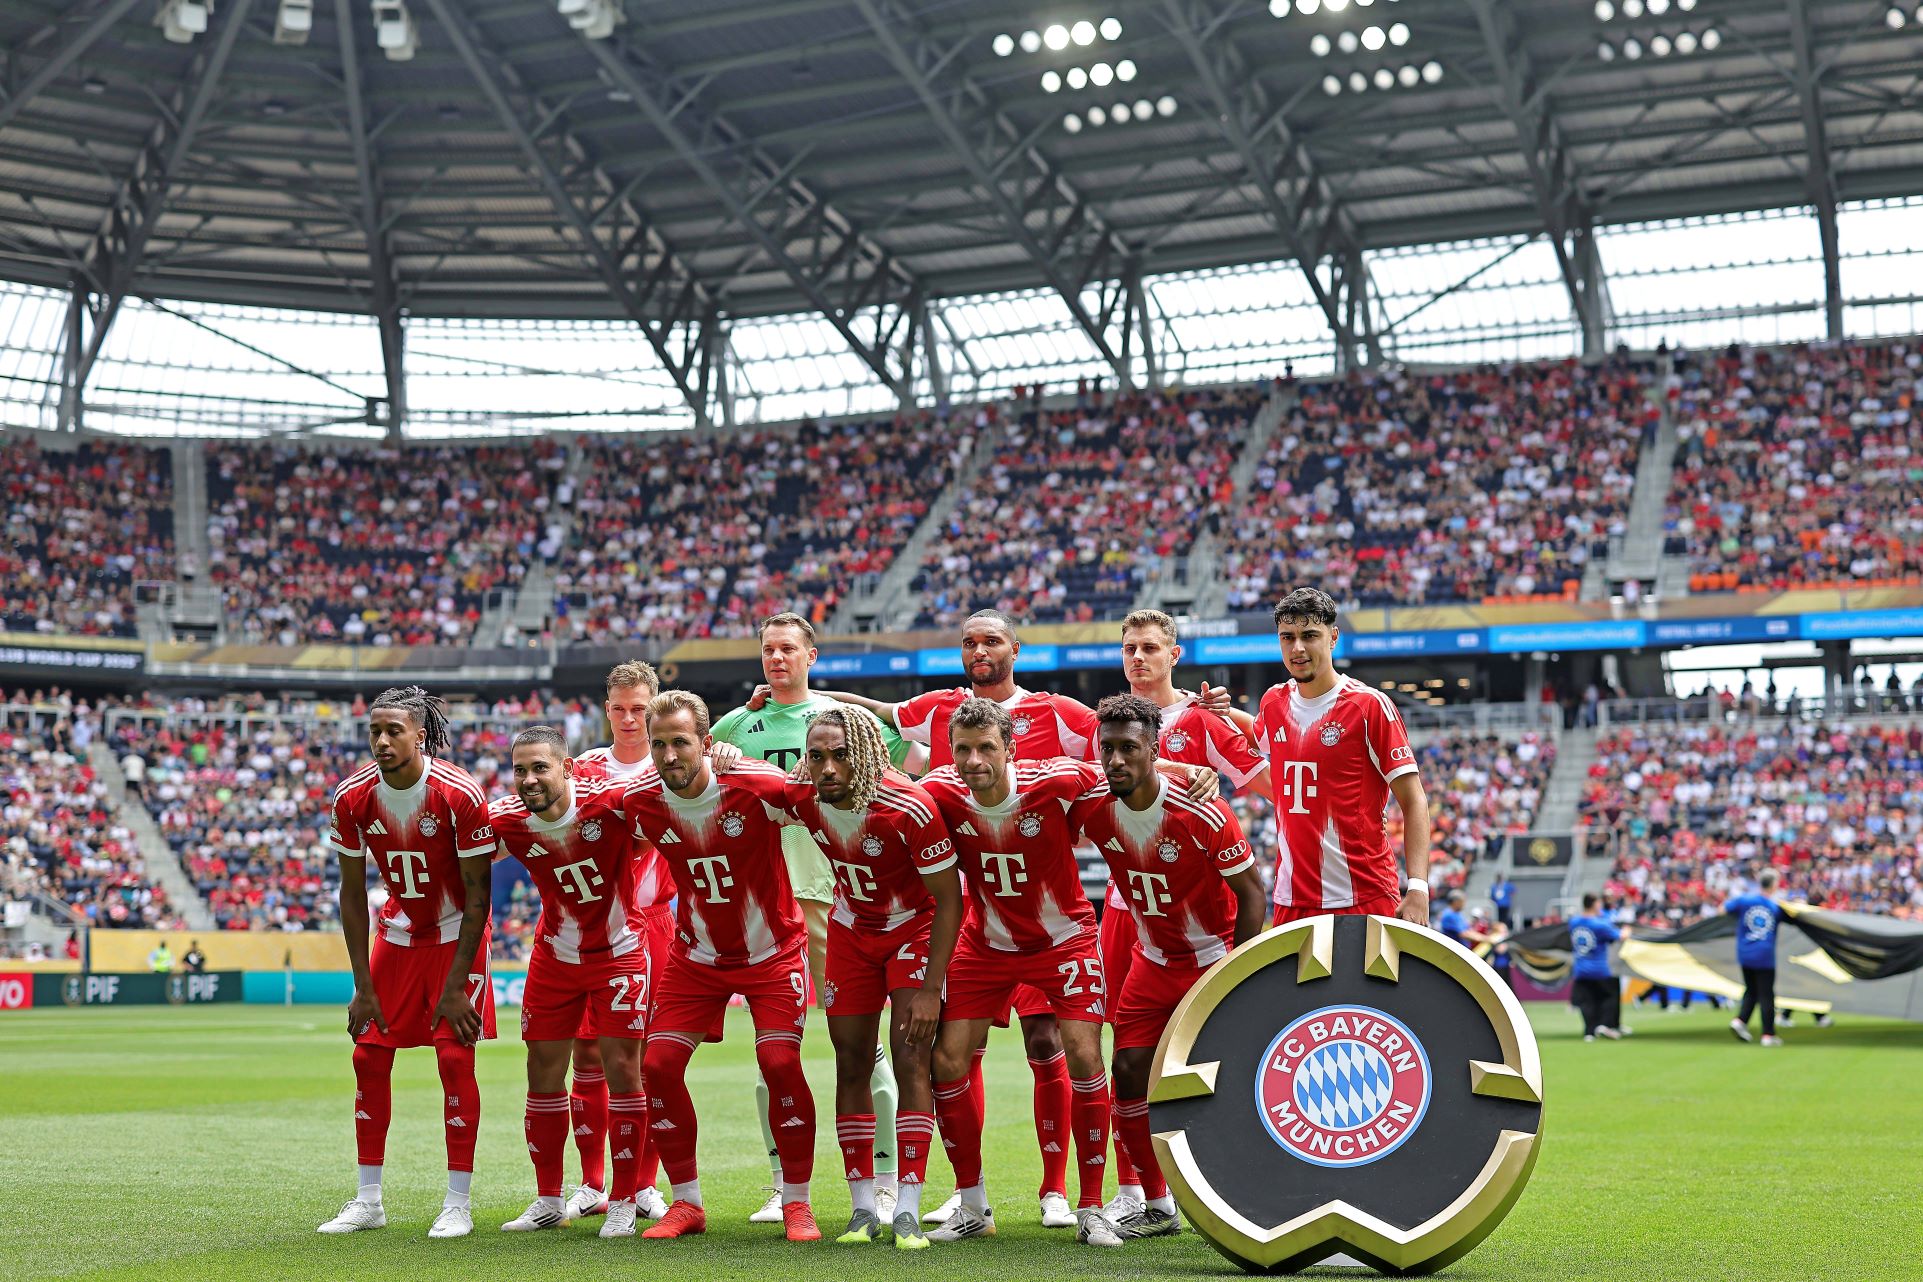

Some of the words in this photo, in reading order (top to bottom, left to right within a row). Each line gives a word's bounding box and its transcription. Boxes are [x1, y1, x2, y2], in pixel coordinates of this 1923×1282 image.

[1283, 760, 1318, 814] T
[386, 851, 430, 899] T
[553, 857, 604, 904] T
[686, 855, 734, 904] T
[832, 858, 878, 902] T
[980, 852, 1028, 897] T
[1127, 869, 1172, 917] T
[86, 975, 120, 1003] PIF
[188, 974, 219, 1001] PIF
[608, 974, 647, 1011] 22
[790, 972, 805, 1007] 9
[1058, 959, 1104, 996] 25
[1271, 1038, 1306, 1075] FC
[1307, 1015, 1418, 1074] BAYERN
[1270, 1099, 1414, 1156] MÜNCHEN
